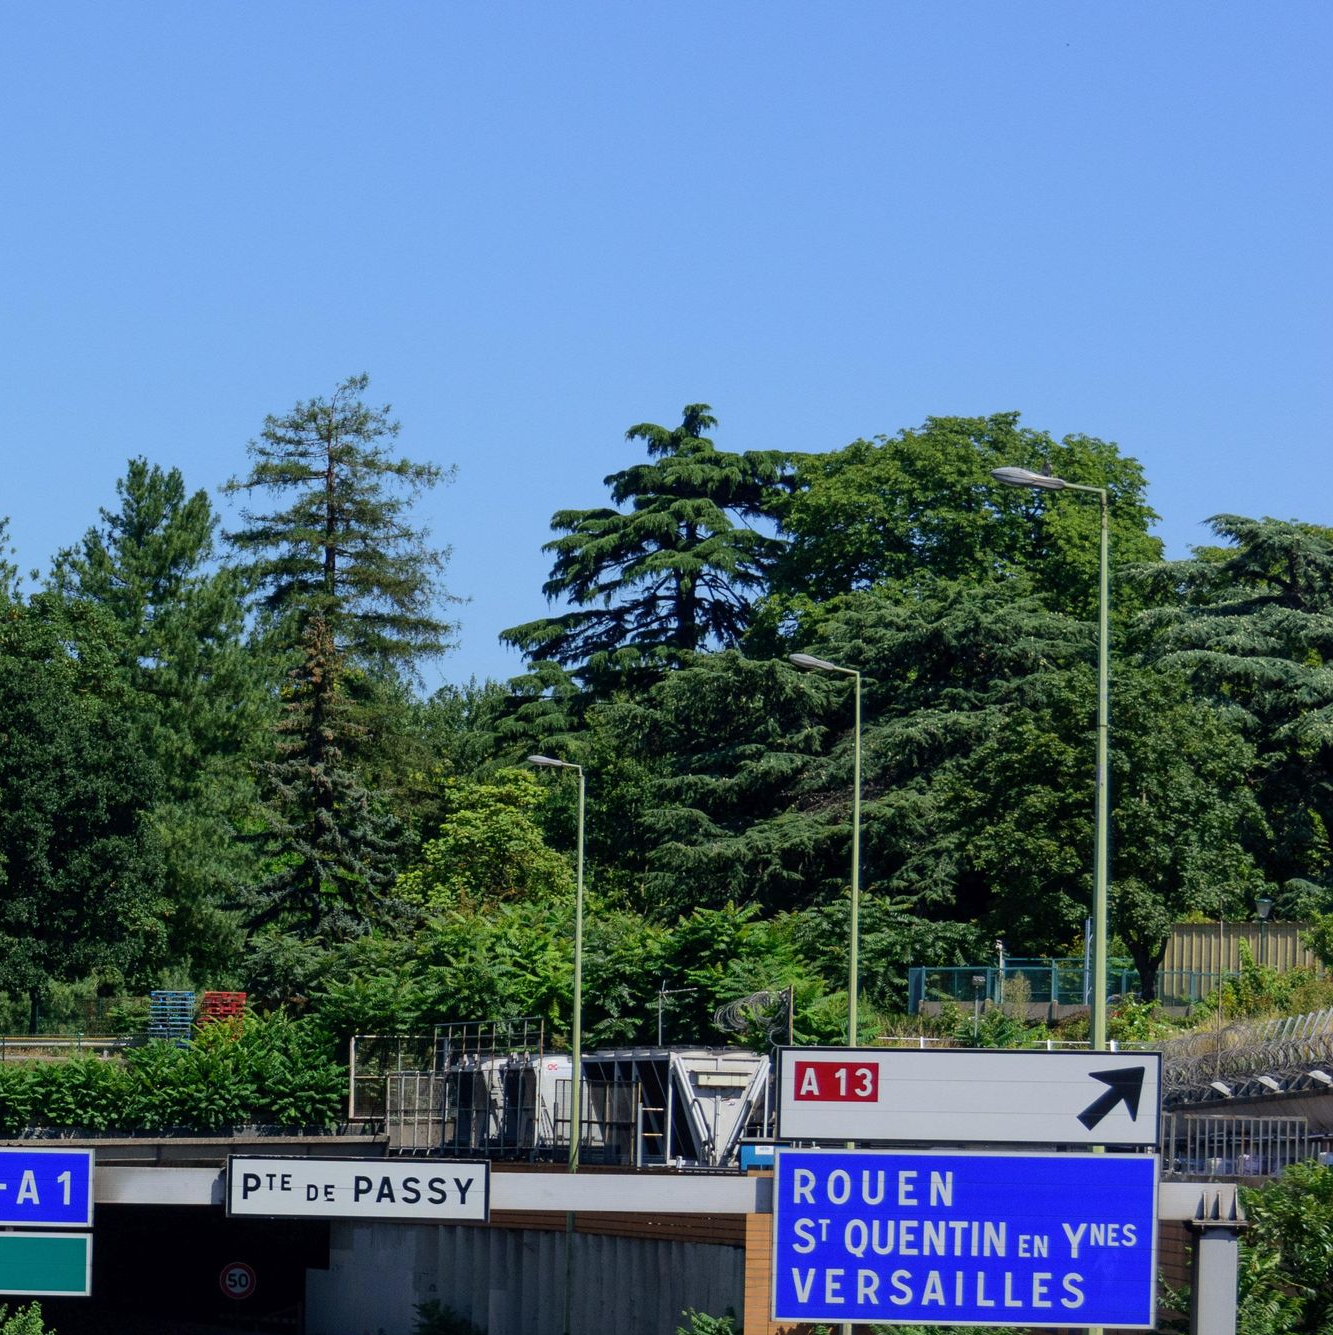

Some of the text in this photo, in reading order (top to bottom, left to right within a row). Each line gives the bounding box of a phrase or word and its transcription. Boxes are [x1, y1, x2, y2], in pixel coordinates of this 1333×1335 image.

[799, 1067, 874, 1097] A 13
[305, 1183, 336, 1203] DE
[353, 1174, 476, 1206] PASSY
[793, 1168, 954, 1207] ROUEN
[843, 1218, 1007, 1258] QUENTIN
[1018, 1234, 1049, 1258] EN
[226, 1271, 250, 1290] 50
[791, 1267, 1086, 1309] VERSAILLES
